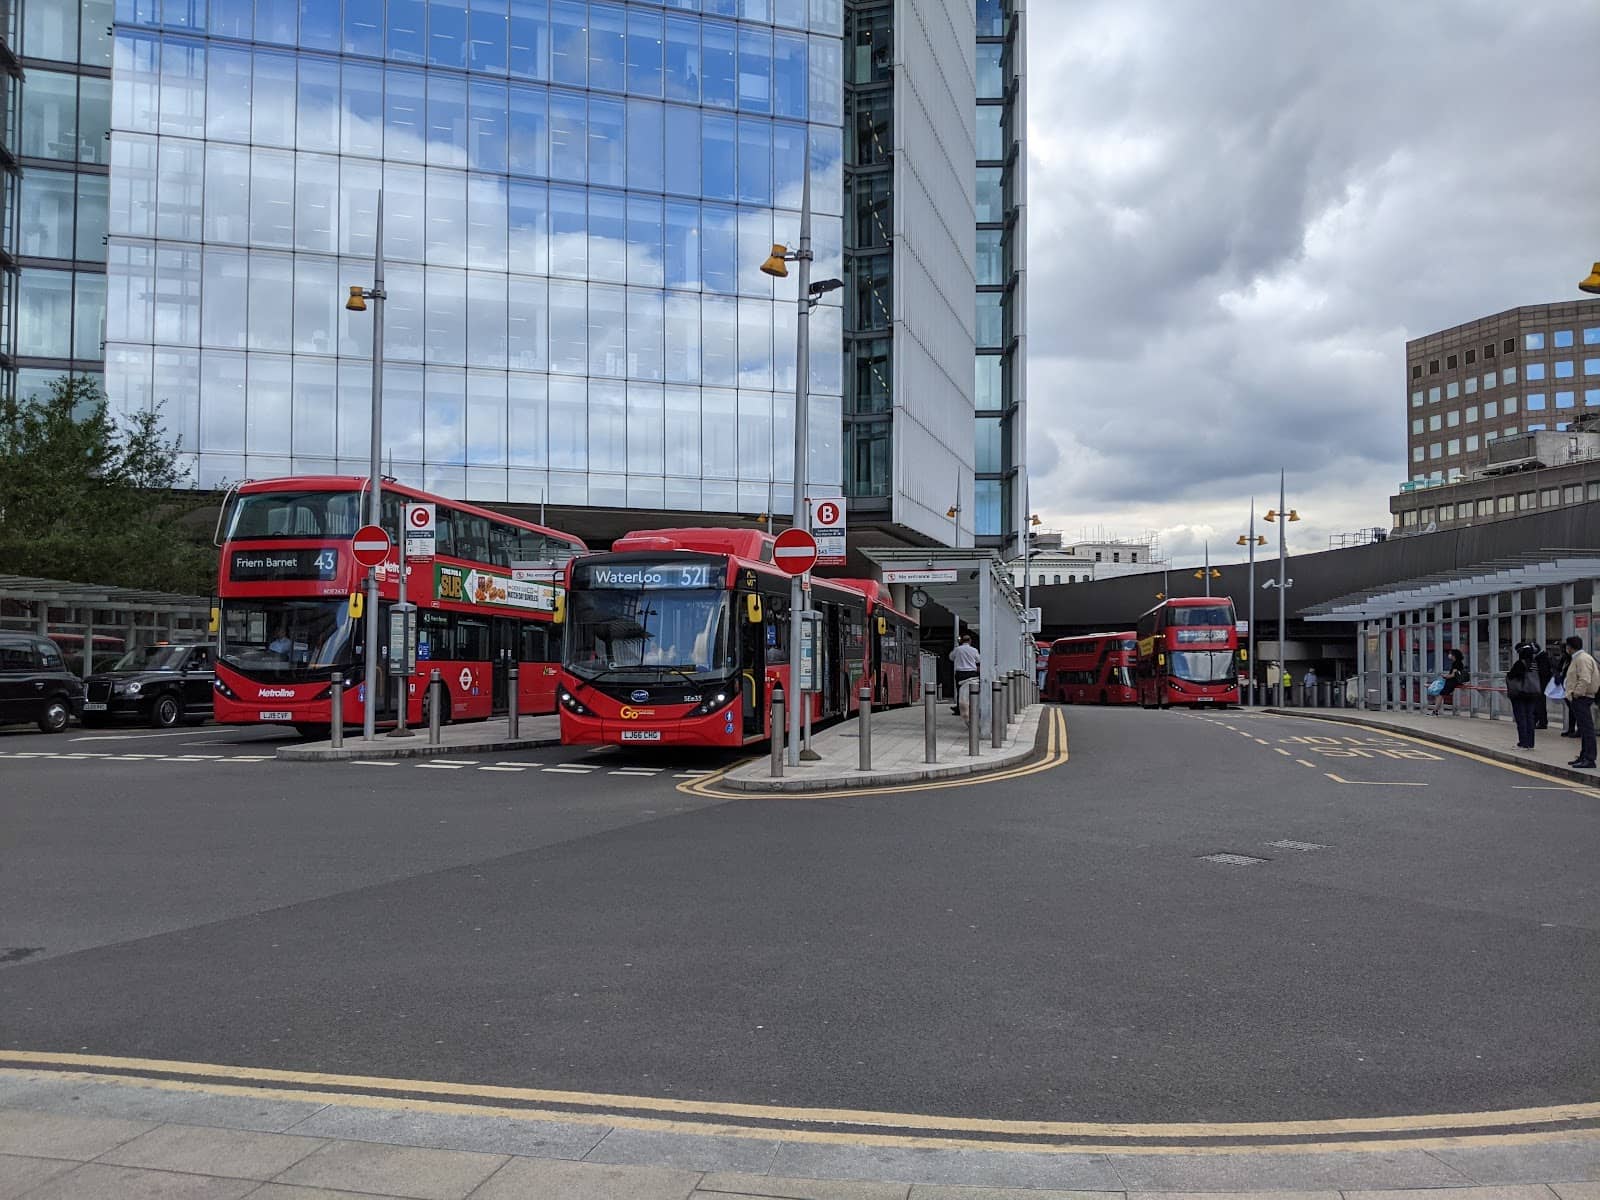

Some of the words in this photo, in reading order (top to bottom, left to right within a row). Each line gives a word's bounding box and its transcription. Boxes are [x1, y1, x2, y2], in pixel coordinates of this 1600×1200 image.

[413, 509, 426, 525] C
[822, 505, 834, 522] B
[236, 557, 264, 568] Friern
[266, 557, 298, 568] Barnet
[313, 552, 335, 570] 43
[595, 570, 662, 584] Waterloo
[680, 566, 707, 586] 521
[441, 574, 462, 597] SUB
[258, 688, 295, 697] Metroline
[620, 705, 639, 720] Go
[624, 731, 642, 739] LJ66
[1278, 736, 1409, 747] STOP
[1309, 746, 1446, 761] BUS
